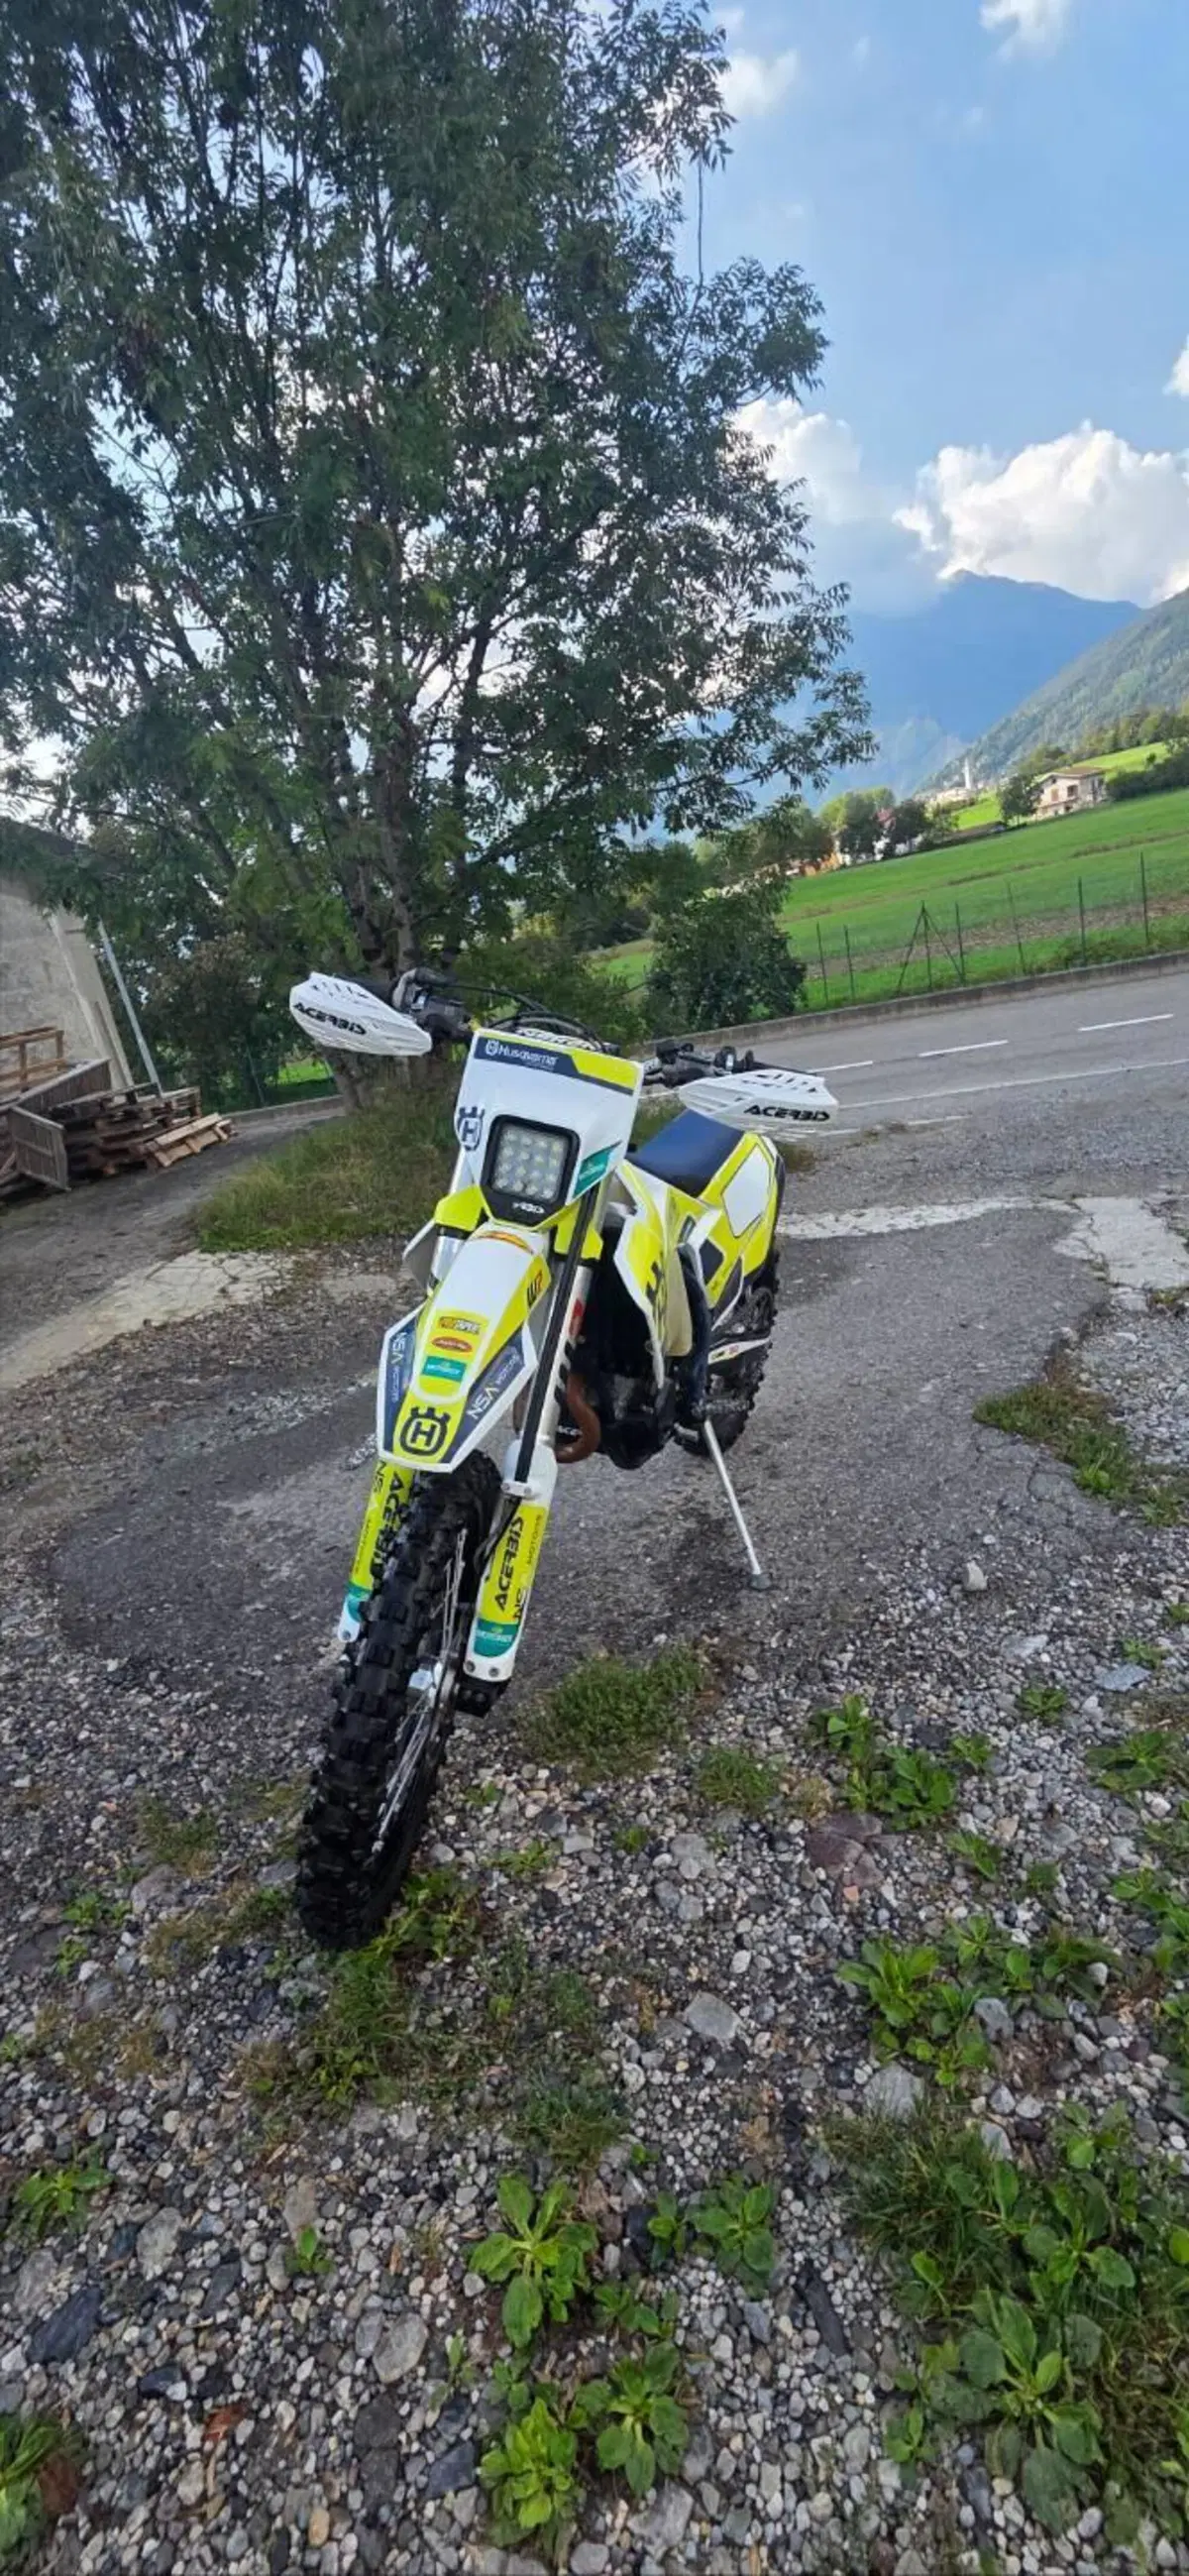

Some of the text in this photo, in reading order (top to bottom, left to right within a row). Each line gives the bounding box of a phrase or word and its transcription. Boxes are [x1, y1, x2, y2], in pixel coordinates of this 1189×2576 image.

[293, 1002, 367, 1036] ACERBIS
[743, 1104, 830, 1123] ACERBIS
[466, 1387, 500, 1420] NSA
[494, 1515, 524, 1613] ACERBIS
